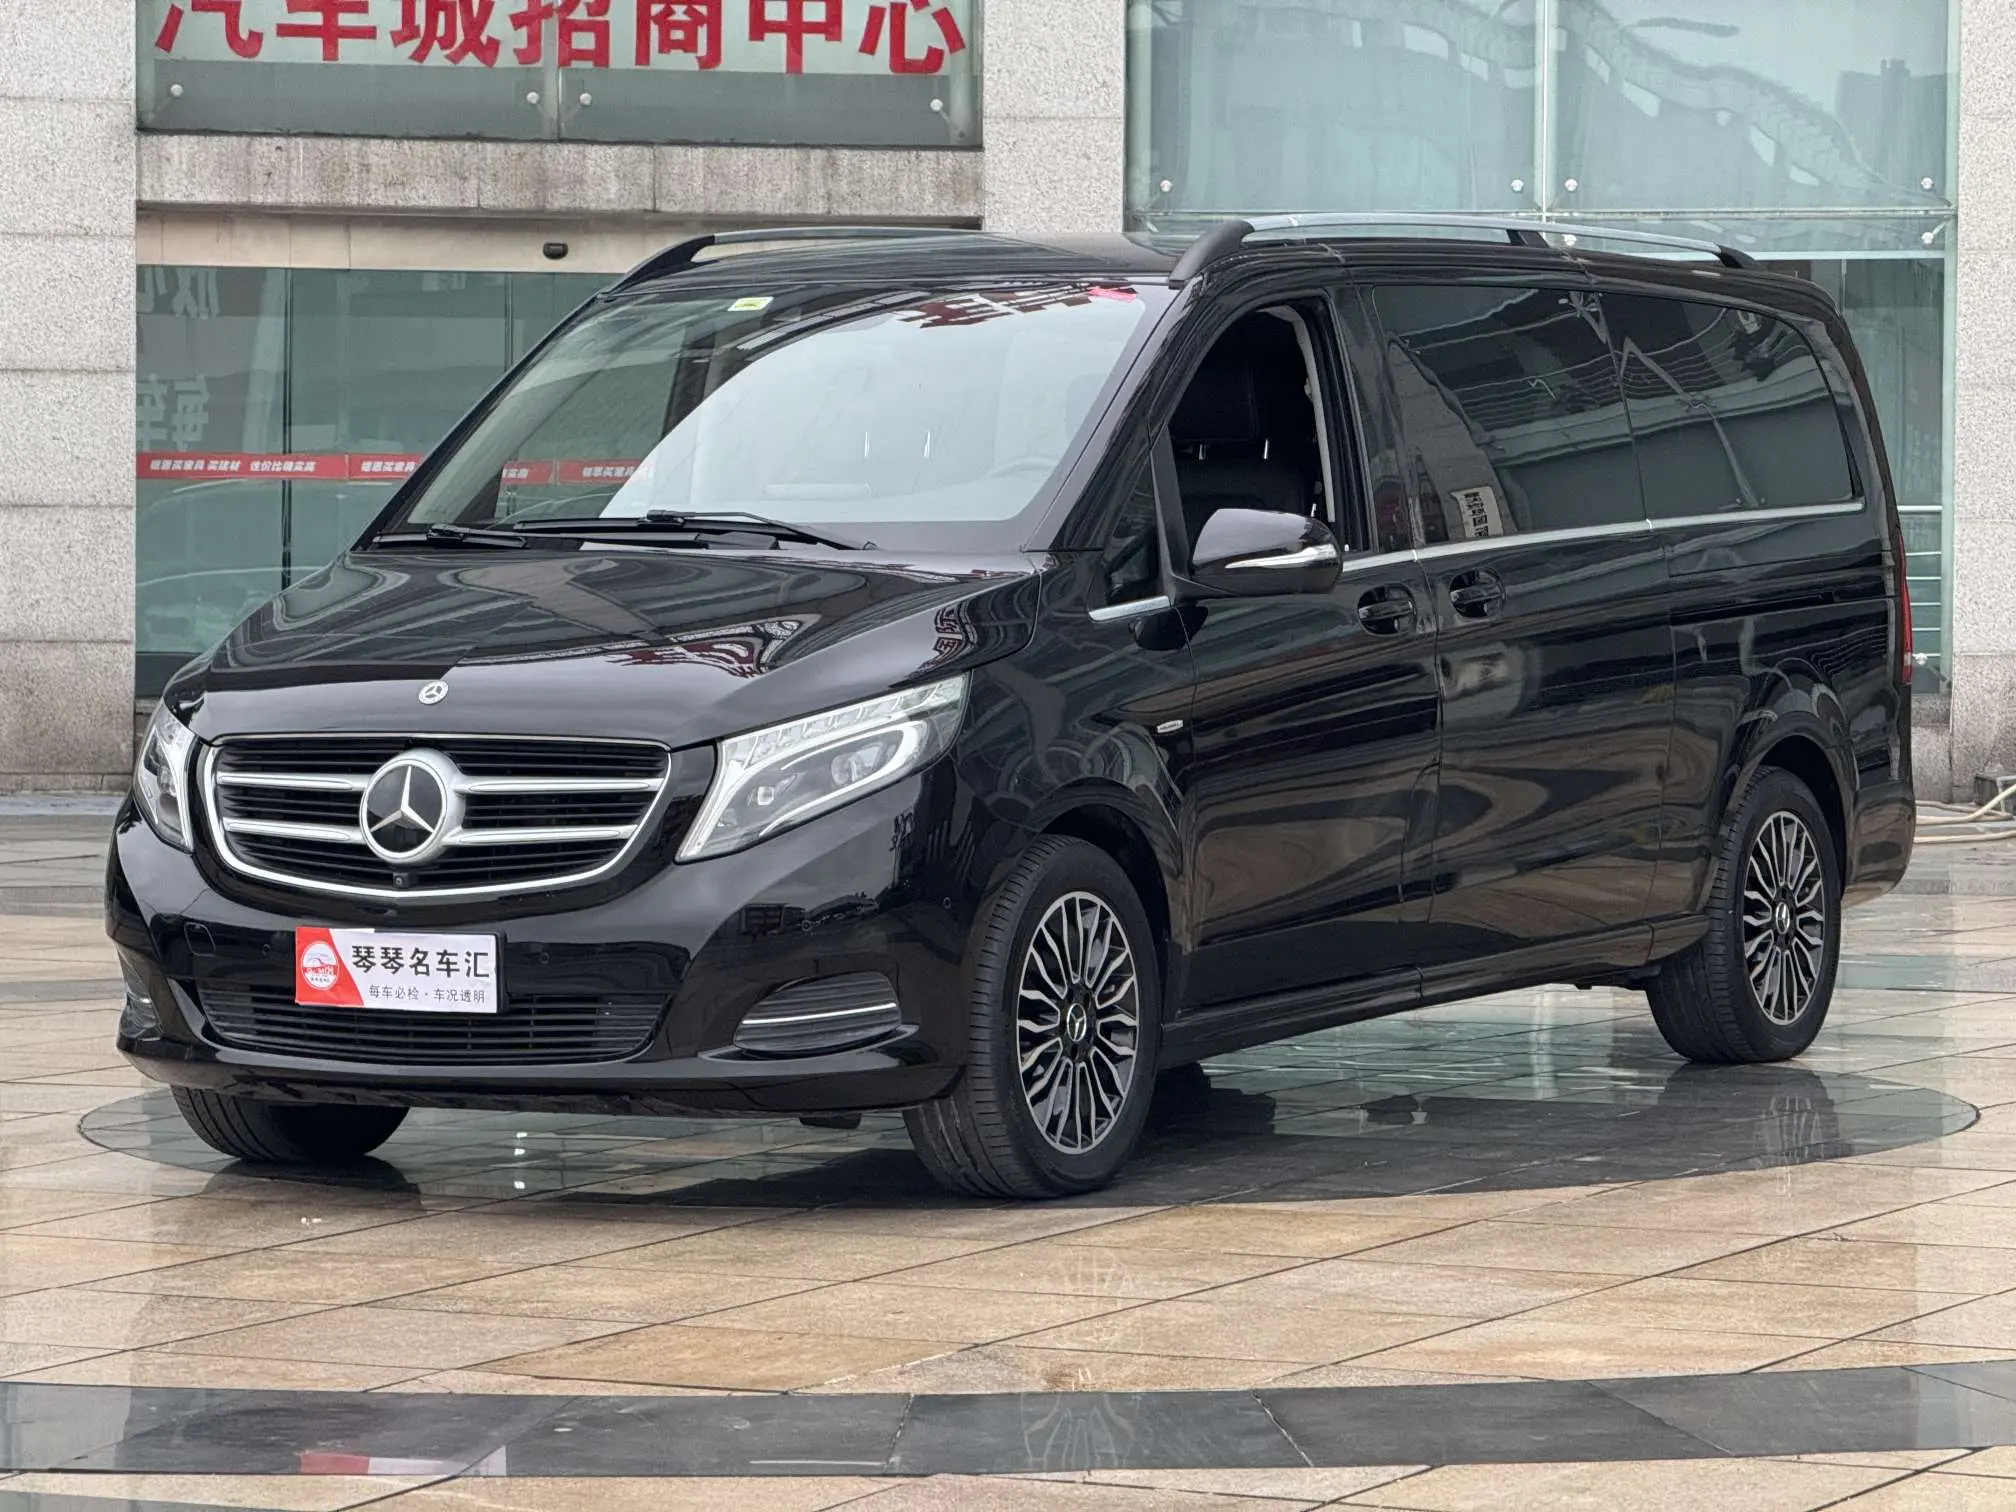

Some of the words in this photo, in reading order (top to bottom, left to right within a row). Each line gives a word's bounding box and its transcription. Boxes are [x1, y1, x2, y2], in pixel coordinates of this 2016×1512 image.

[155, 0, 967, 74] 汽车城招商中心
[352, 945, 490, 978] 琴琴名车汇
